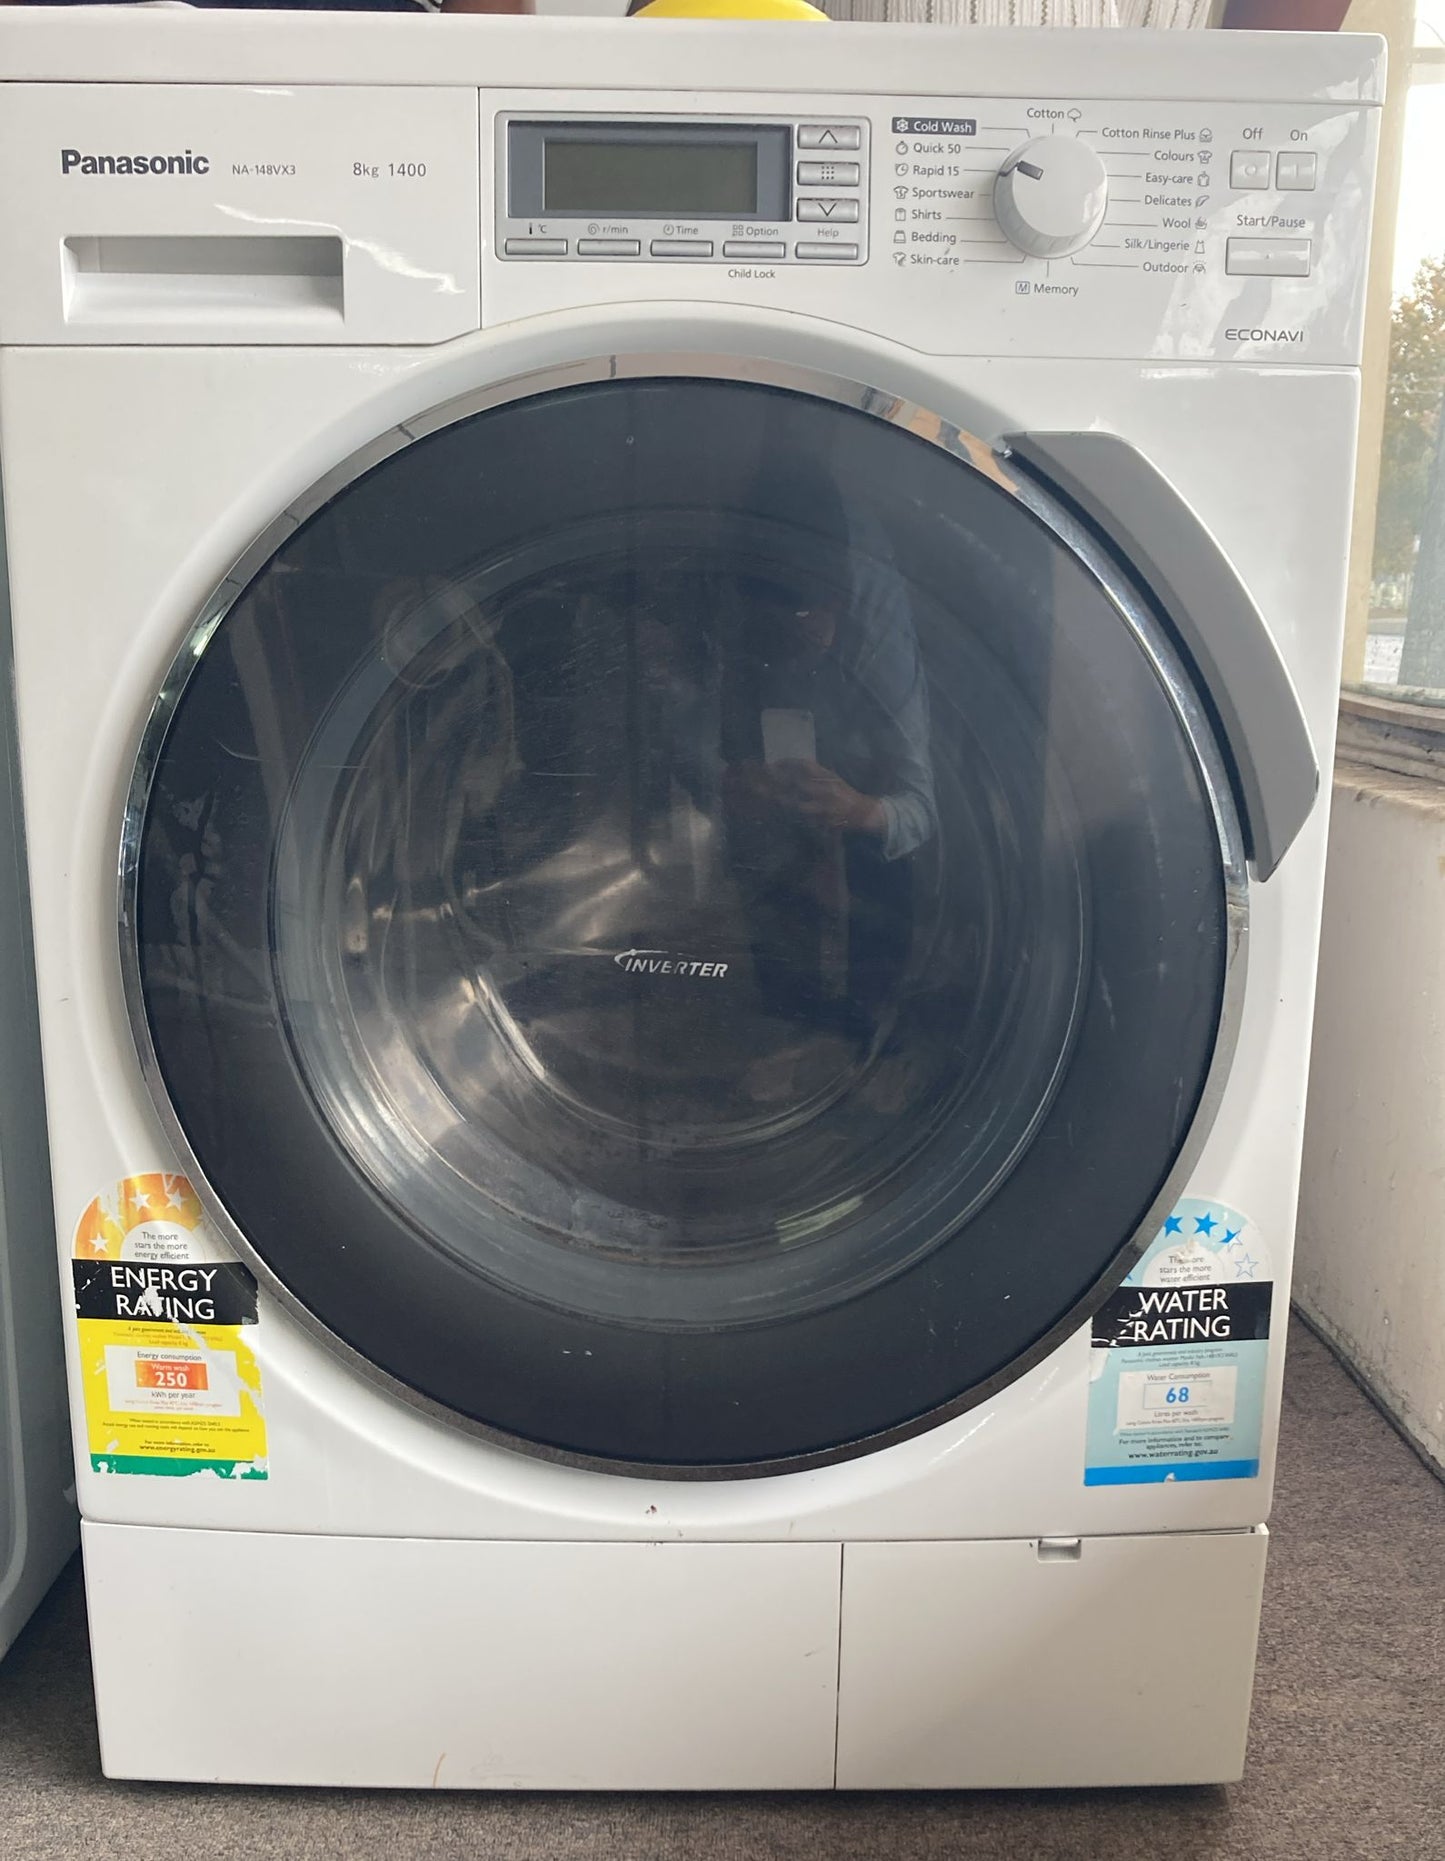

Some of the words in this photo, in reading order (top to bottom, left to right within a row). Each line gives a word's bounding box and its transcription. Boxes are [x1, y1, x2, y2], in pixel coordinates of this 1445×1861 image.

[1027, 107, 1065, 119] Cotton
[913, 120, 939, 132] Cold
[941, 121, 972, 133] Wash
[1102, 127, 1140, 139] Cotton
[1143, 128, 1172, 139] Rinse
[1174, 129, 1196, 140] Plus
[1242, 127, 1264, 140] Off
[1290, 129, 1308, 141] On
[913, 142, 944, 154] Quick
[947, 143, 961, 154] 50
[61, 149, 210, 175] Panasonic
[1154, 150, 1195, 161] Colours
[232, 164, 297, 176] NA-148VX3
[353, 162, 380, 178] 8kg
[388, 163, 427, 177] 1400
[912, 164, 945, 178] Rapid
[947, 166, 960, 176] 15
[1145, 172, 1194, 186] Easy-care
[912, 187, 975, 200] Sportswear
[1144, 194, 1192, 207] Delicates
[911, 209, 942, 220] Shirts
[1236, 214, 1306, 228] Start/Pause
[602, 224, 629, 235] r/min
[1162, 217, 1191, 229] Wool
[676, 225, 699, 235] Time
[746, 225, 779, 238] Option
[817, 228, 840, 238] Help
[911, 231, 957, 246] Bedding
[1124, 238, 1190, 253] Silk/Lingerie
[910, 254, 960, 266] Skin-care
[728, 268, 752, 279] Child
[754, 269, 776, 279] Lock
[1143, 262, 1189, 273] Outdoor
[1034, 283, 1079, 297] Memory
[1225, 328, 1304, 342] ECONAVI
[624, 957, 729, 978] INVERTER
[142, 1231, 156, 1240] The
[134, 1242, 152, 1250] stars
[153, 1241, 165, 1250] the
[134, 1251, 158, 1261] energy
[160, 1251, 190, 1260] efficient
[1179, 1265, 1191, 1273] the
[110, 1265, 218, 1292] ENERGY
[1137, 1288, 1229, 1314] WATER
[1133, 1315, 1231, 1342] RATING
[137, 1351, 159, 1361] Energy
[160, 1353, 202, 1362] consumption
[151, 1362, 172, 1371] Warm
[173, 1364, 190, 1372] wash
[155, 1371, 188, 1388] 250
[151, 1391, 167, 1399] kWh
[168, 1392, 180, 1400] per
[181, 1392, 196, 1400] year
[1165, 1386, 1190, 1404] 68
